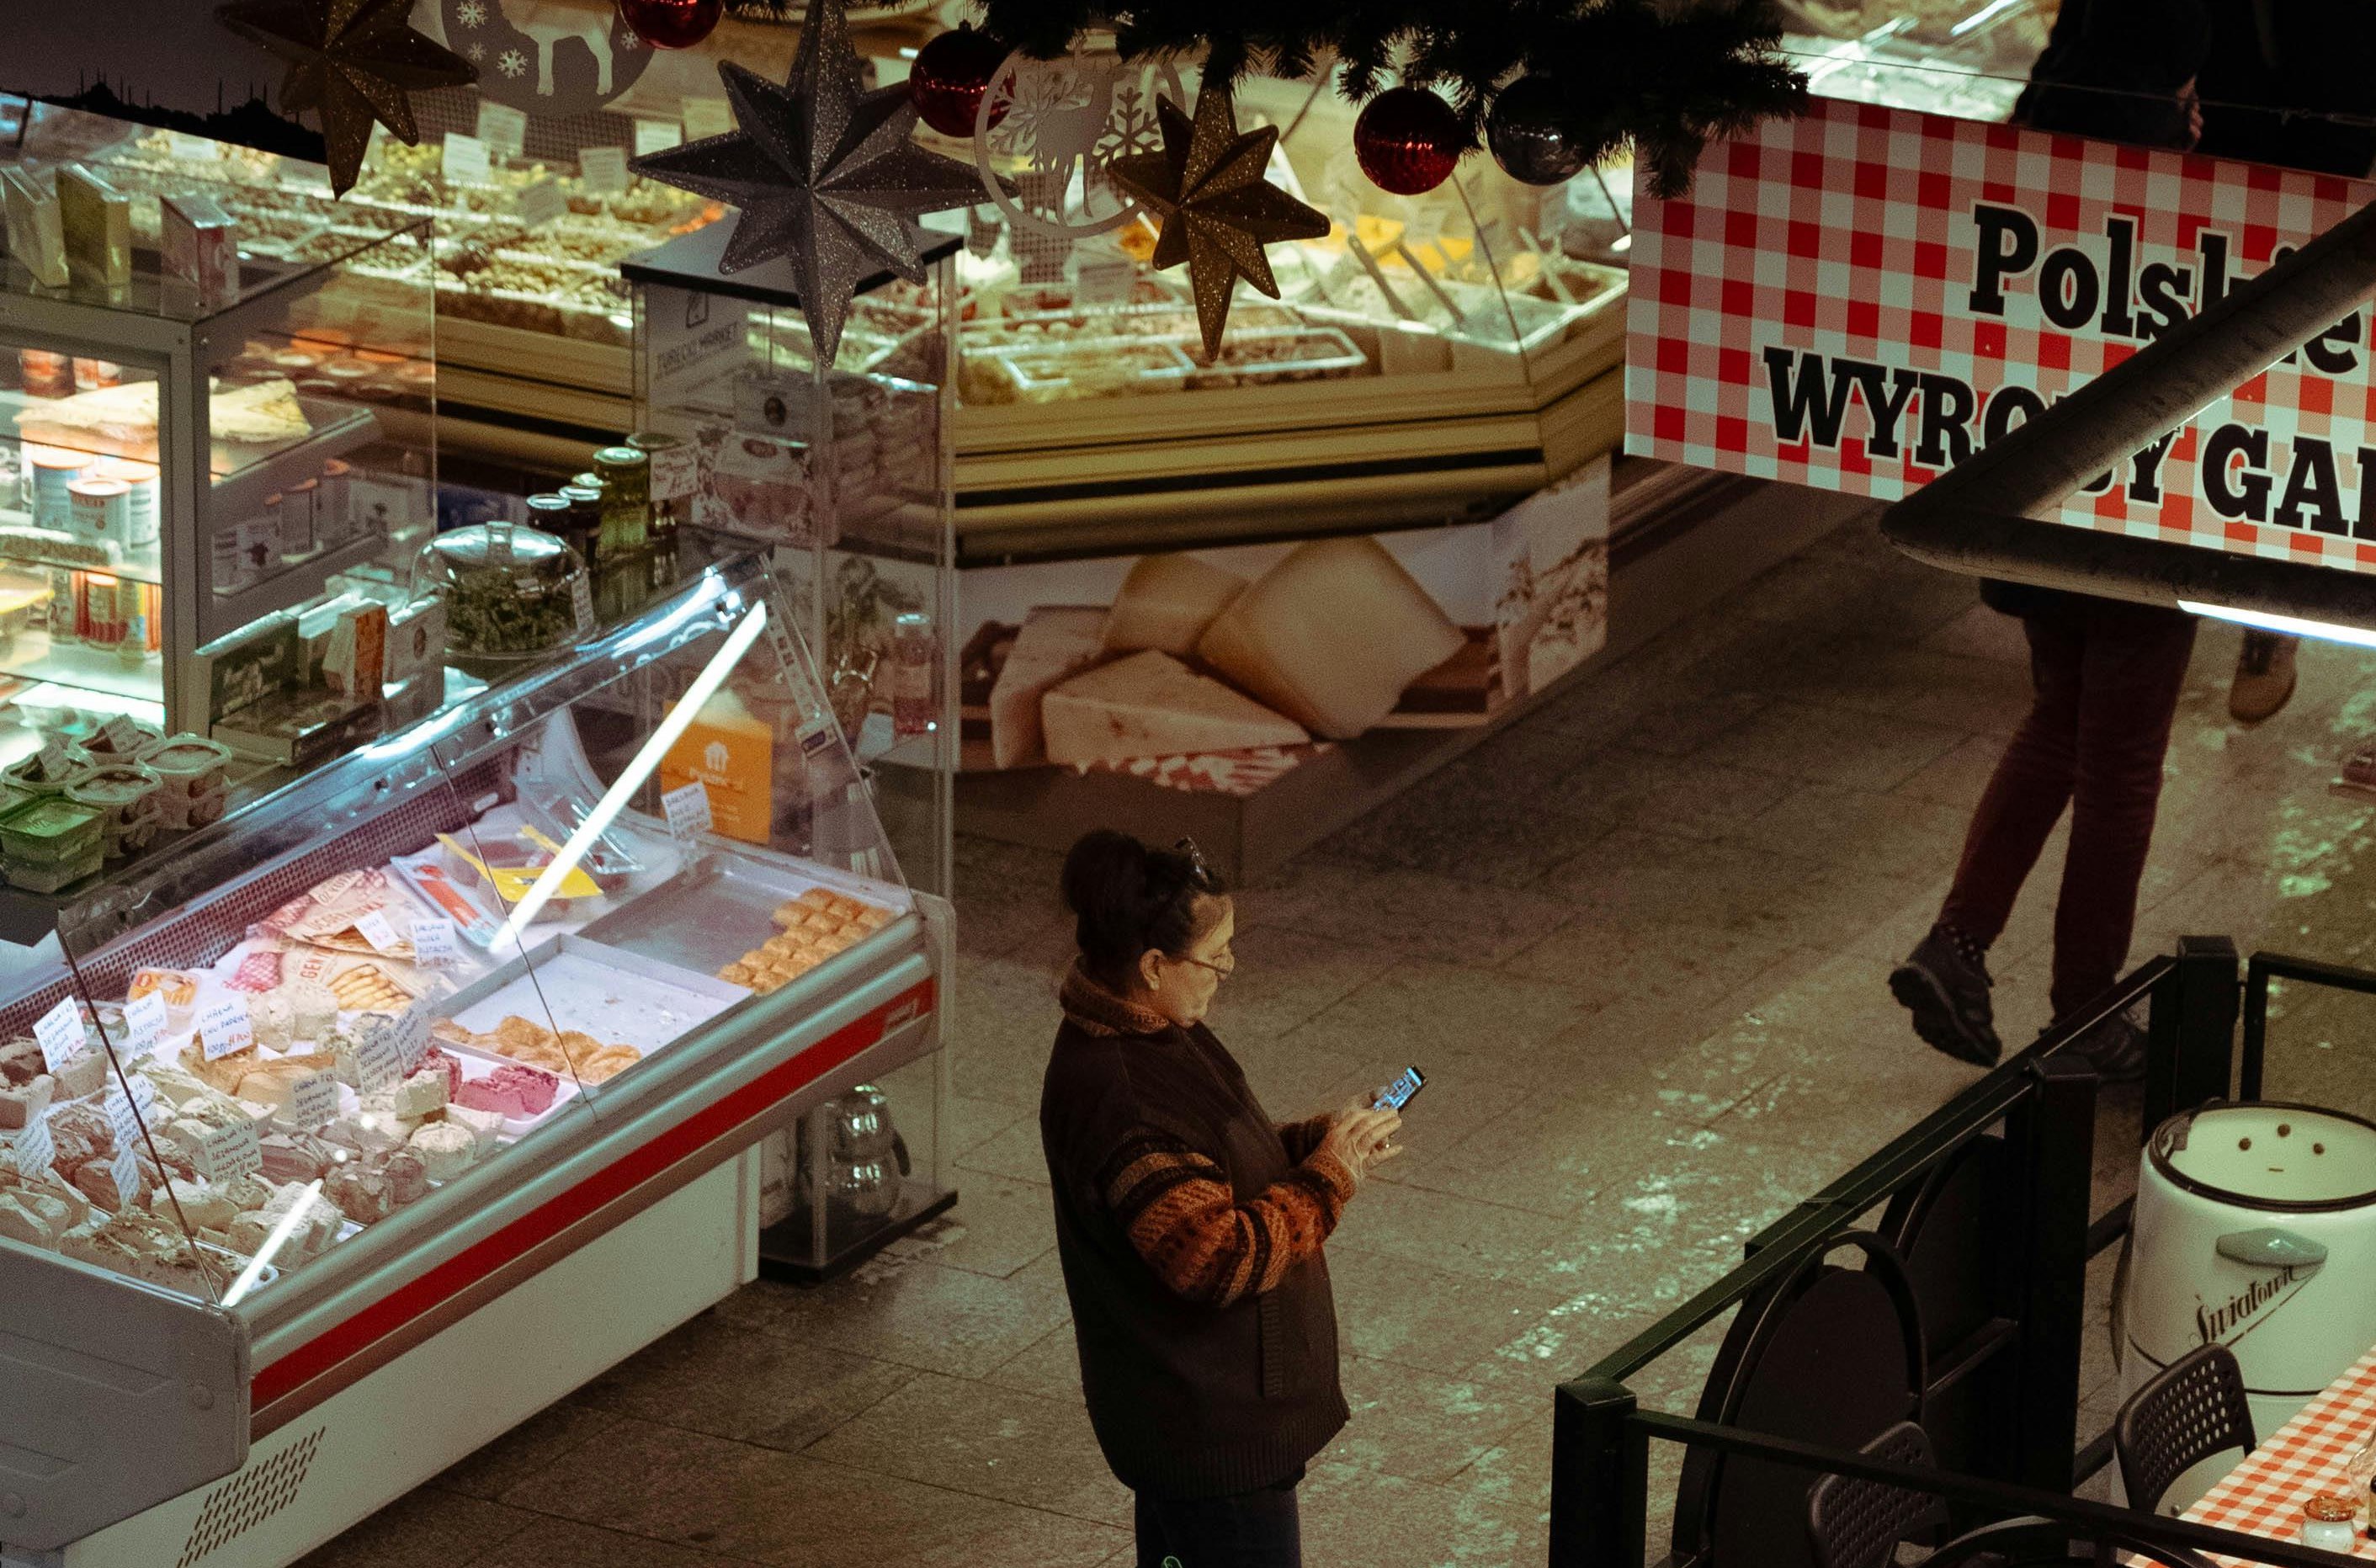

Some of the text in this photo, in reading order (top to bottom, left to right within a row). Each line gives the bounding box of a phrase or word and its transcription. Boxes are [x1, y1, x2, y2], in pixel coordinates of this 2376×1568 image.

[1968, 203, 2362, 375] Polske
[1764, 347, 2376, 541] WYROY GA
